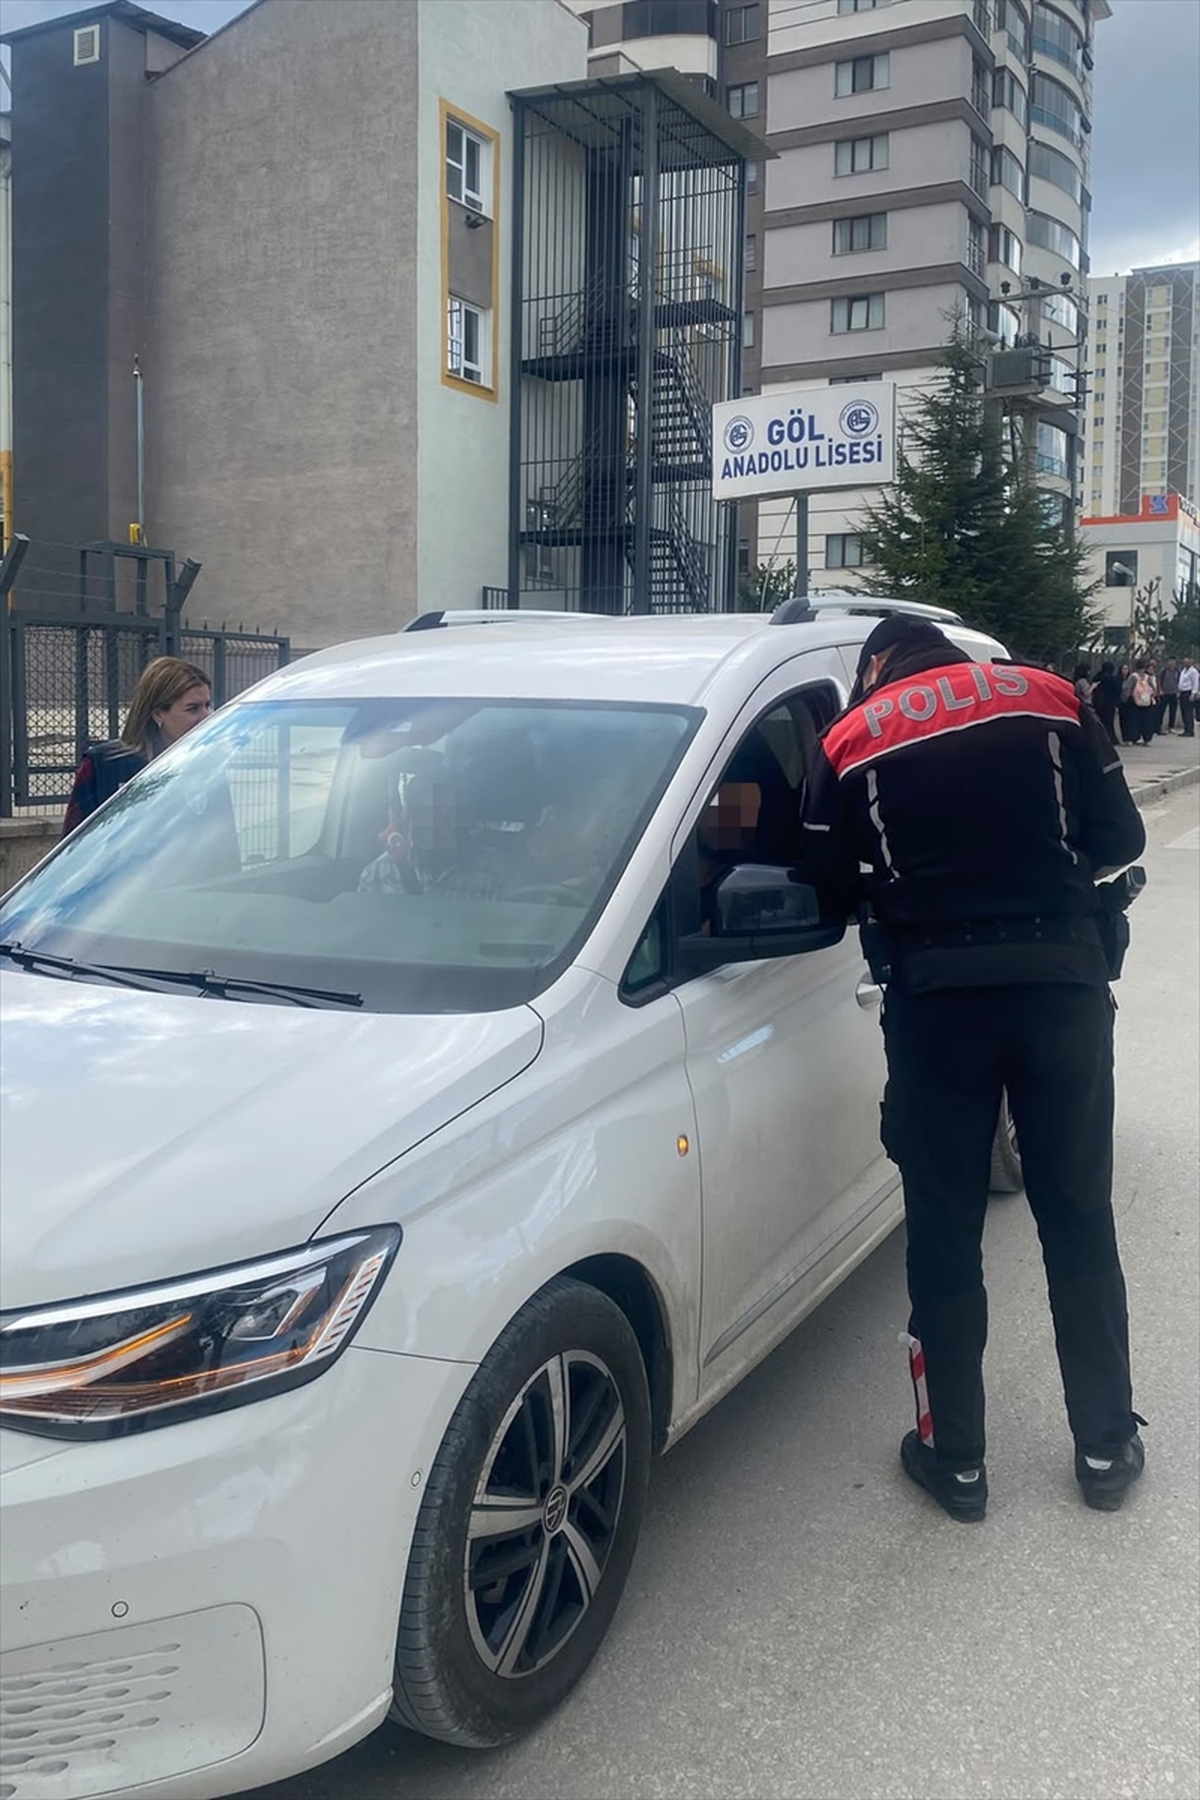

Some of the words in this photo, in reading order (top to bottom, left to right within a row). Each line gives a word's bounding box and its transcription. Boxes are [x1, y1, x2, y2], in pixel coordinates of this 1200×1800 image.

[767, 408, 825, 445] GÖL
[721, 446, 808, 480] ANADOLU
[815, 434, 882, 467] LİSESİ
